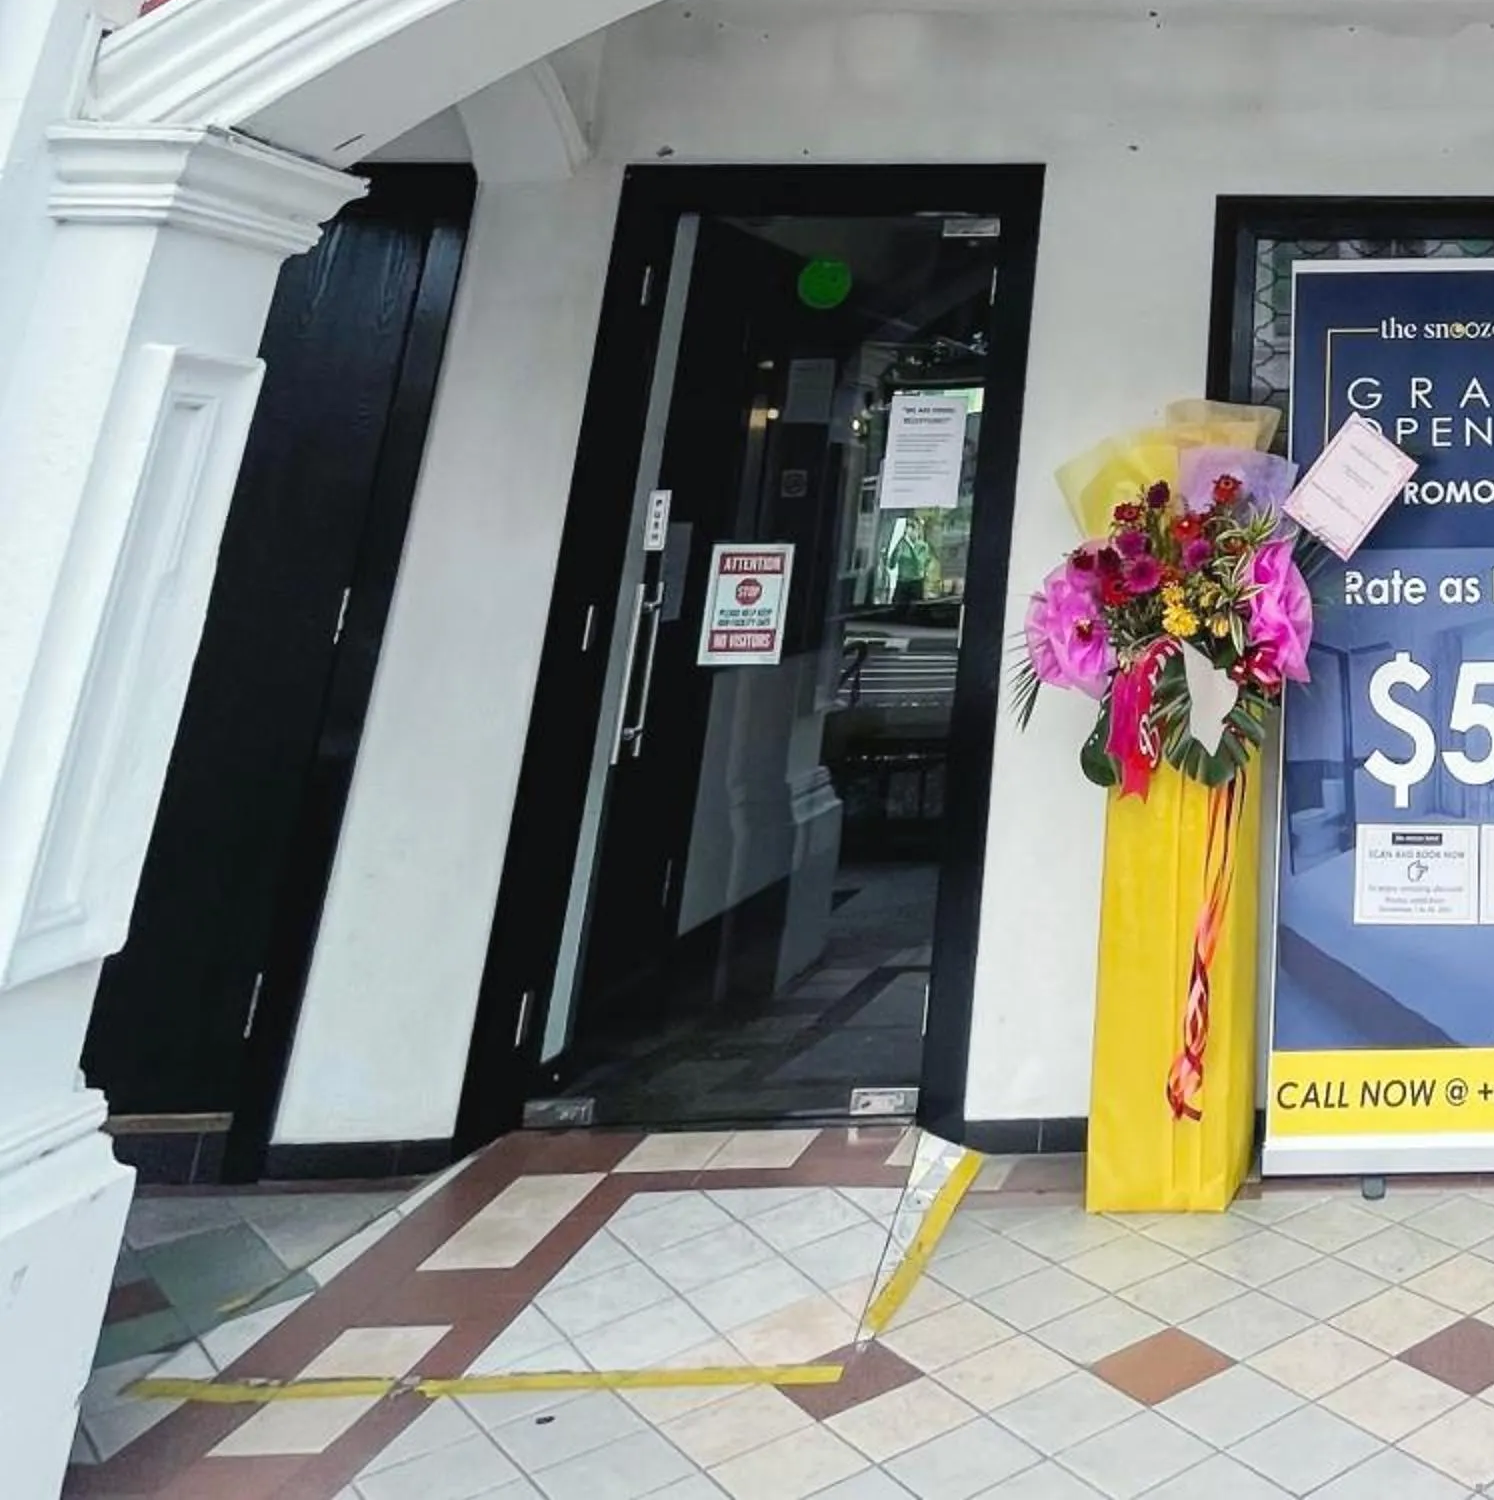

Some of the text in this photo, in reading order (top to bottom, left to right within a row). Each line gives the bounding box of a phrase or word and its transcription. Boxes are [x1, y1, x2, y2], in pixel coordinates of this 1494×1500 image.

[1381, 316, 1417, 339] the
[723, 556, 781, 572] ATTENTION
[737, 585, 761, 598] STOP
[1345, 568, 1427, 605] Rate
[1439, 574, 1481, 604] as
[713, 633, 772, 649] NO VISITORS
[1276, 1081, 1349, 1110] CALL
[1360, 1079, 1437, 1108] NOW
[1445, 1077, 1469, 1107] @
